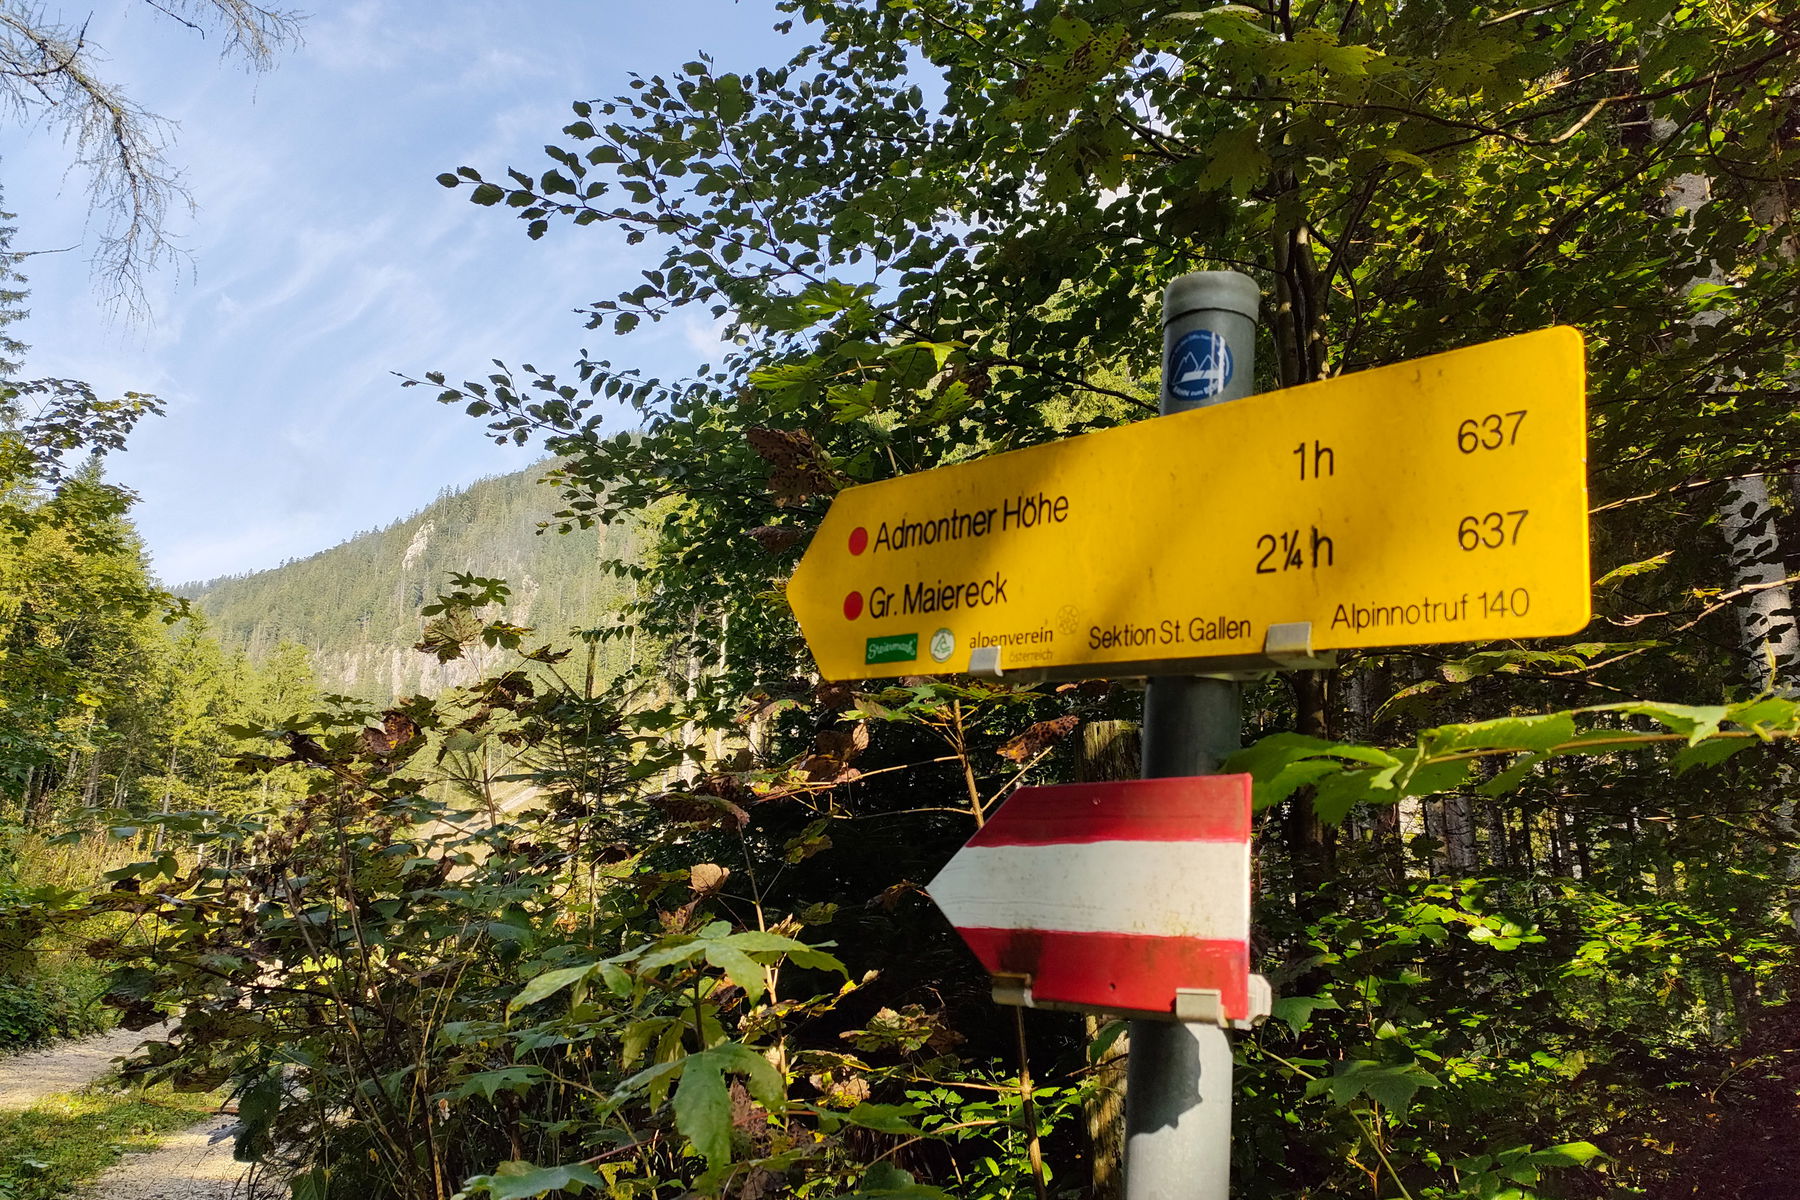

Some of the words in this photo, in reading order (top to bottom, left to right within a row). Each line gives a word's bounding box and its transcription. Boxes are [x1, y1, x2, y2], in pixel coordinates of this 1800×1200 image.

[1457, 409, 1528, 455] 637
[873, 508, 997, 553] Admontner
[1002, 492, 1069, 531] Höhe
[1457, 510, 1529, 552] 637
[869, 586, 898, 619] Gr.
[902, 571, 1008, 615] Maiereck
[1330, 593, 1469, 633] Alpinnotruf
[1477, 587, 1530, 618] 140
[969, 626, 1053, 649] alpenverein
[1088, 625, 1156, 649] Sektion
[1160, 619, 1186, 644] St.
[1188, 616, 1252, 642] Gallen
